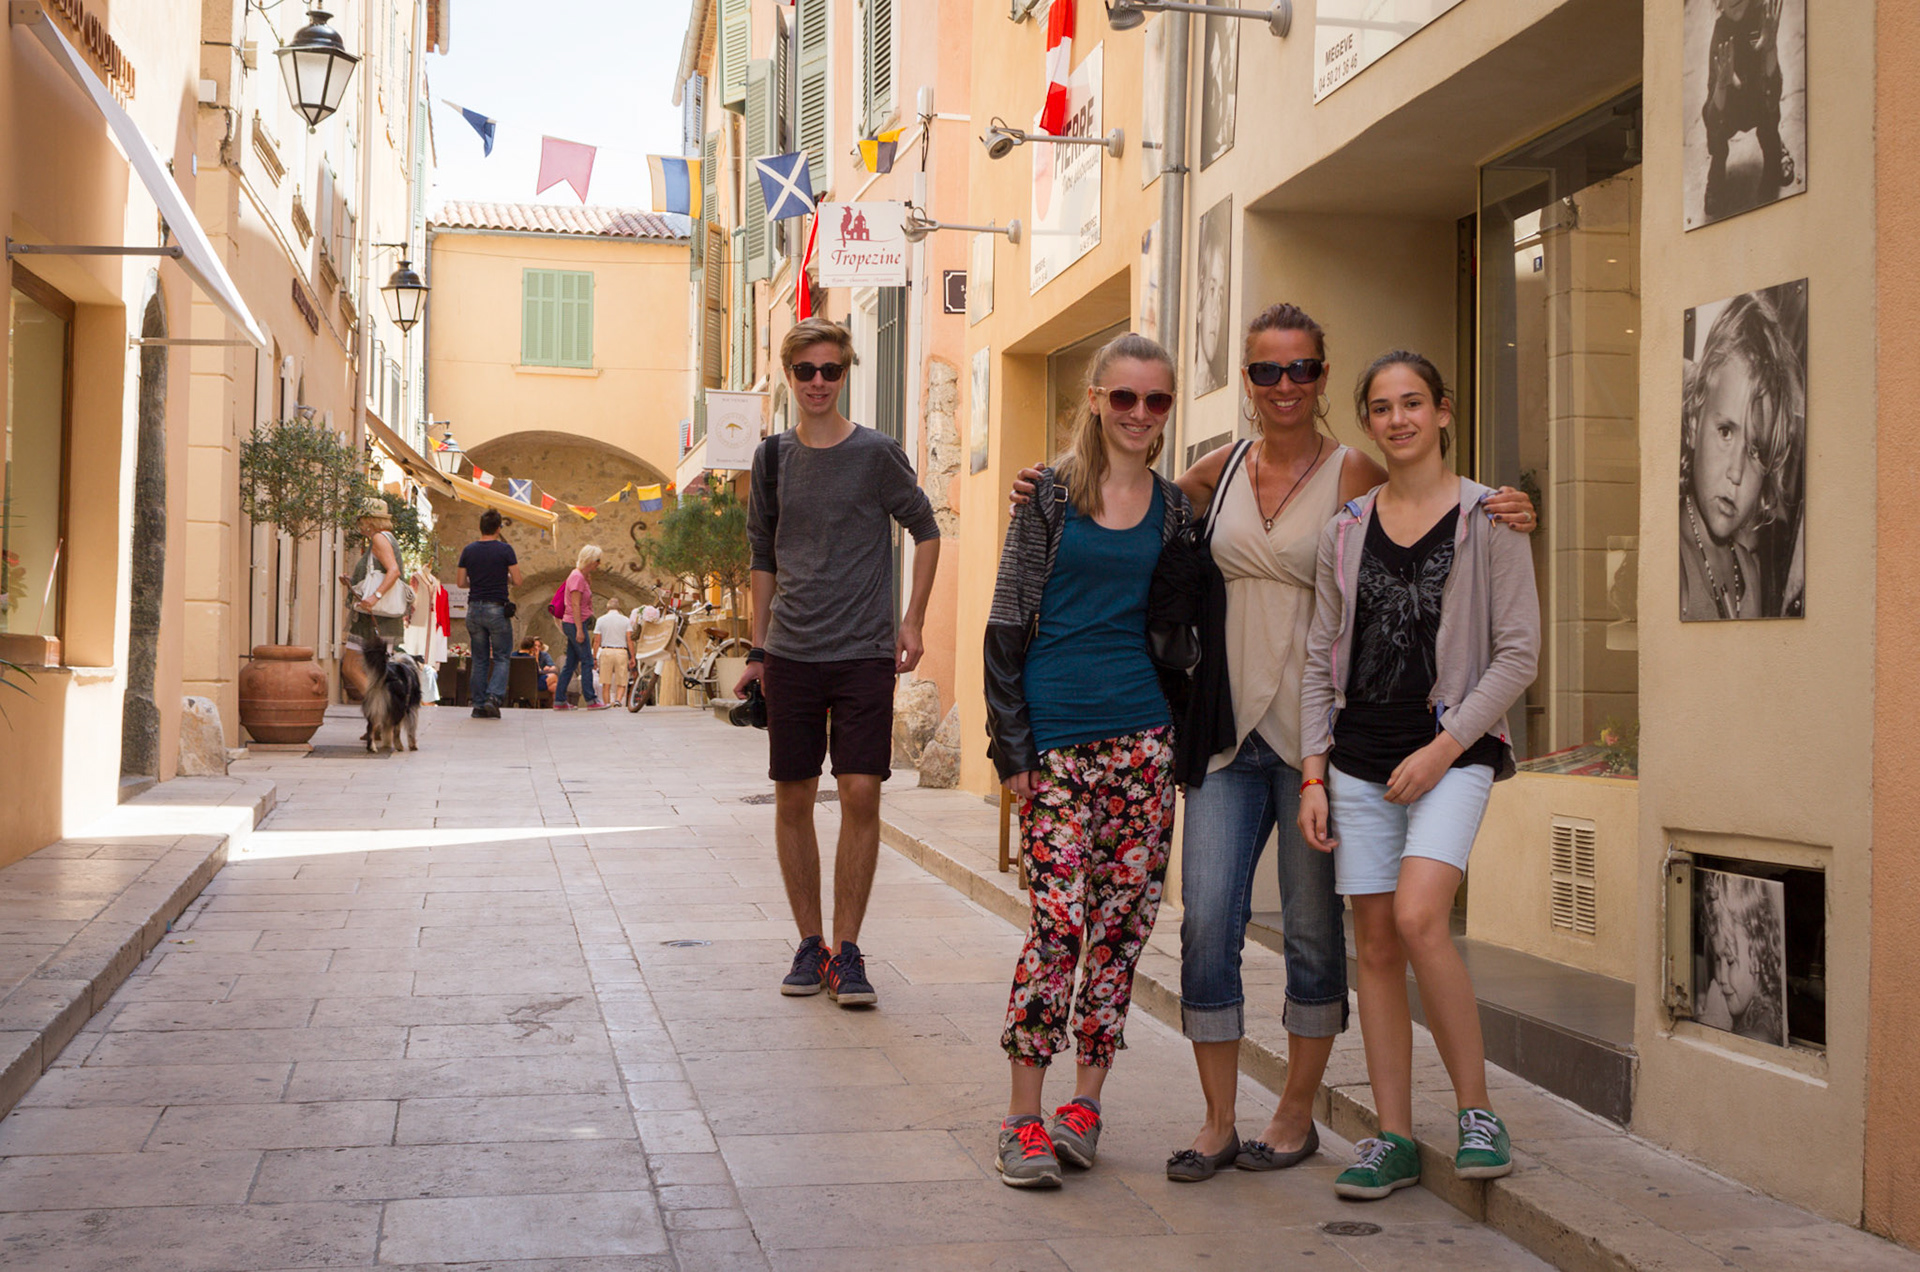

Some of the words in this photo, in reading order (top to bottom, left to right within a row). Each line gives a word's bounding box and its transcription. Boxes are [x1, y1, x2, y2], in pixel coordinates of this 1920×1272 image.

[1325, 33, 1353, 67] MEGEVE
[1319, 76, 1326, 92] 04
[1327, 70, 1333, 87] 50
[1335, 65, 1341, 82] 21
[1054, 96, 1095, 180] PIERRE
[831, 247, 901, 273] Tropezine
